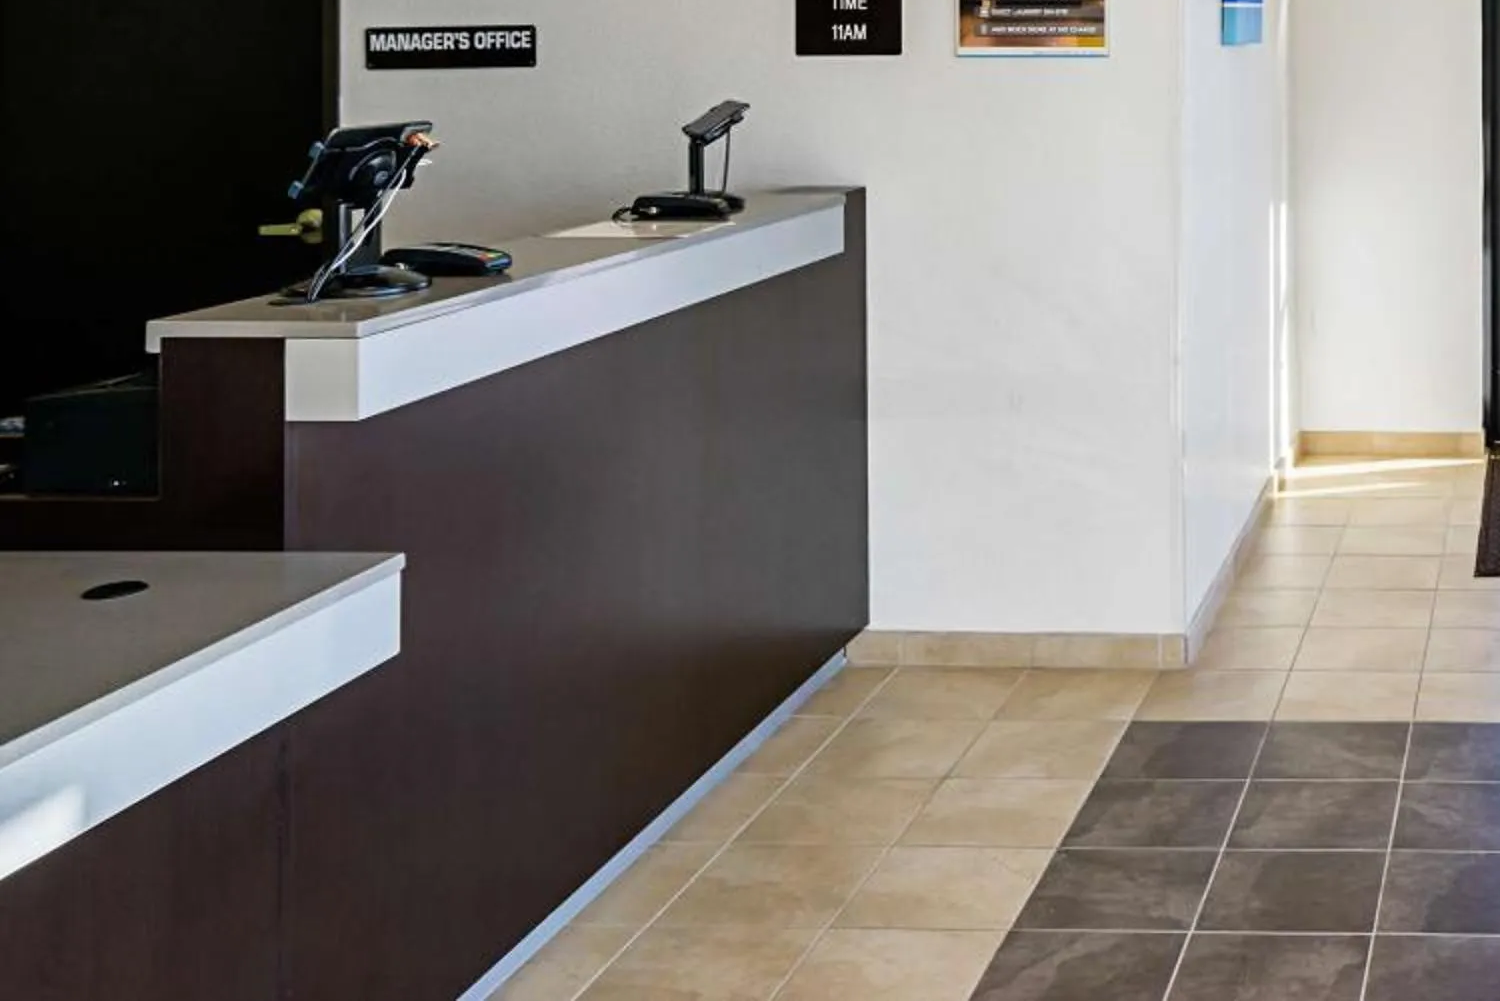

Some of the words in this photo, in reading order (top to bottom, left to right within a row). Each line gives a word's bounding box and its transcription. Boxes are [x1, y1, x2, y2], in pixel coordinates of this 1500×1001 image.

[369, 32, 470, 52] MANAGER'S
[474, 30, 532, 50] OFFICE
[832, 23, 867, 40] 11AM
